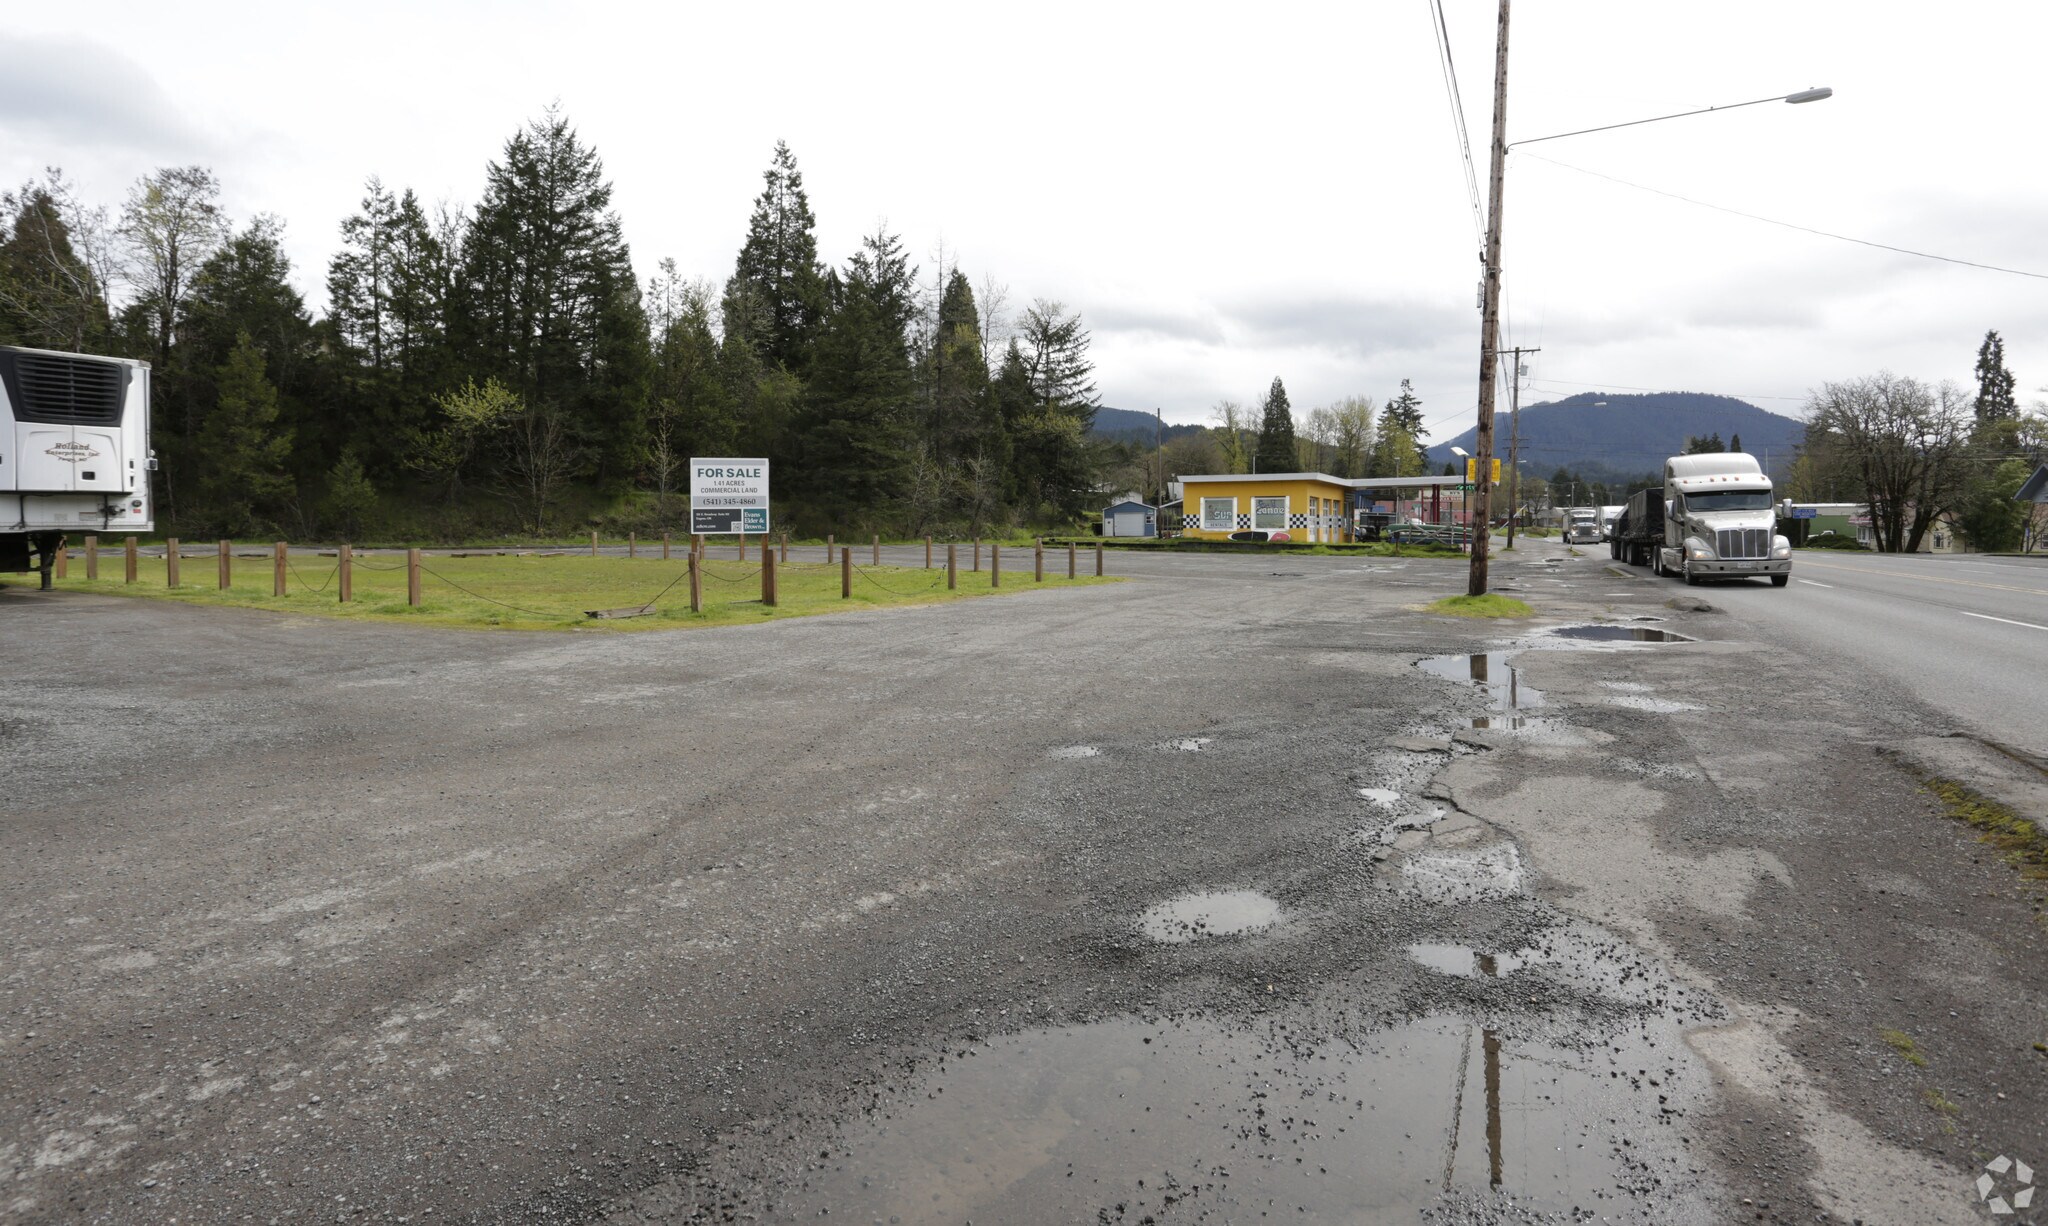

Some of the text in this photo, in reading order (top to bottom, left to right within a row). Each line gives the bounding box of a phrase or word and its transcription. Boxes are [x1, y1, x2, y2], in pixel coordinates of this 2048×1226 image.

[697, 468, 761, 478] FOR SALE
[1214, 511, 1232, 519] SUP
